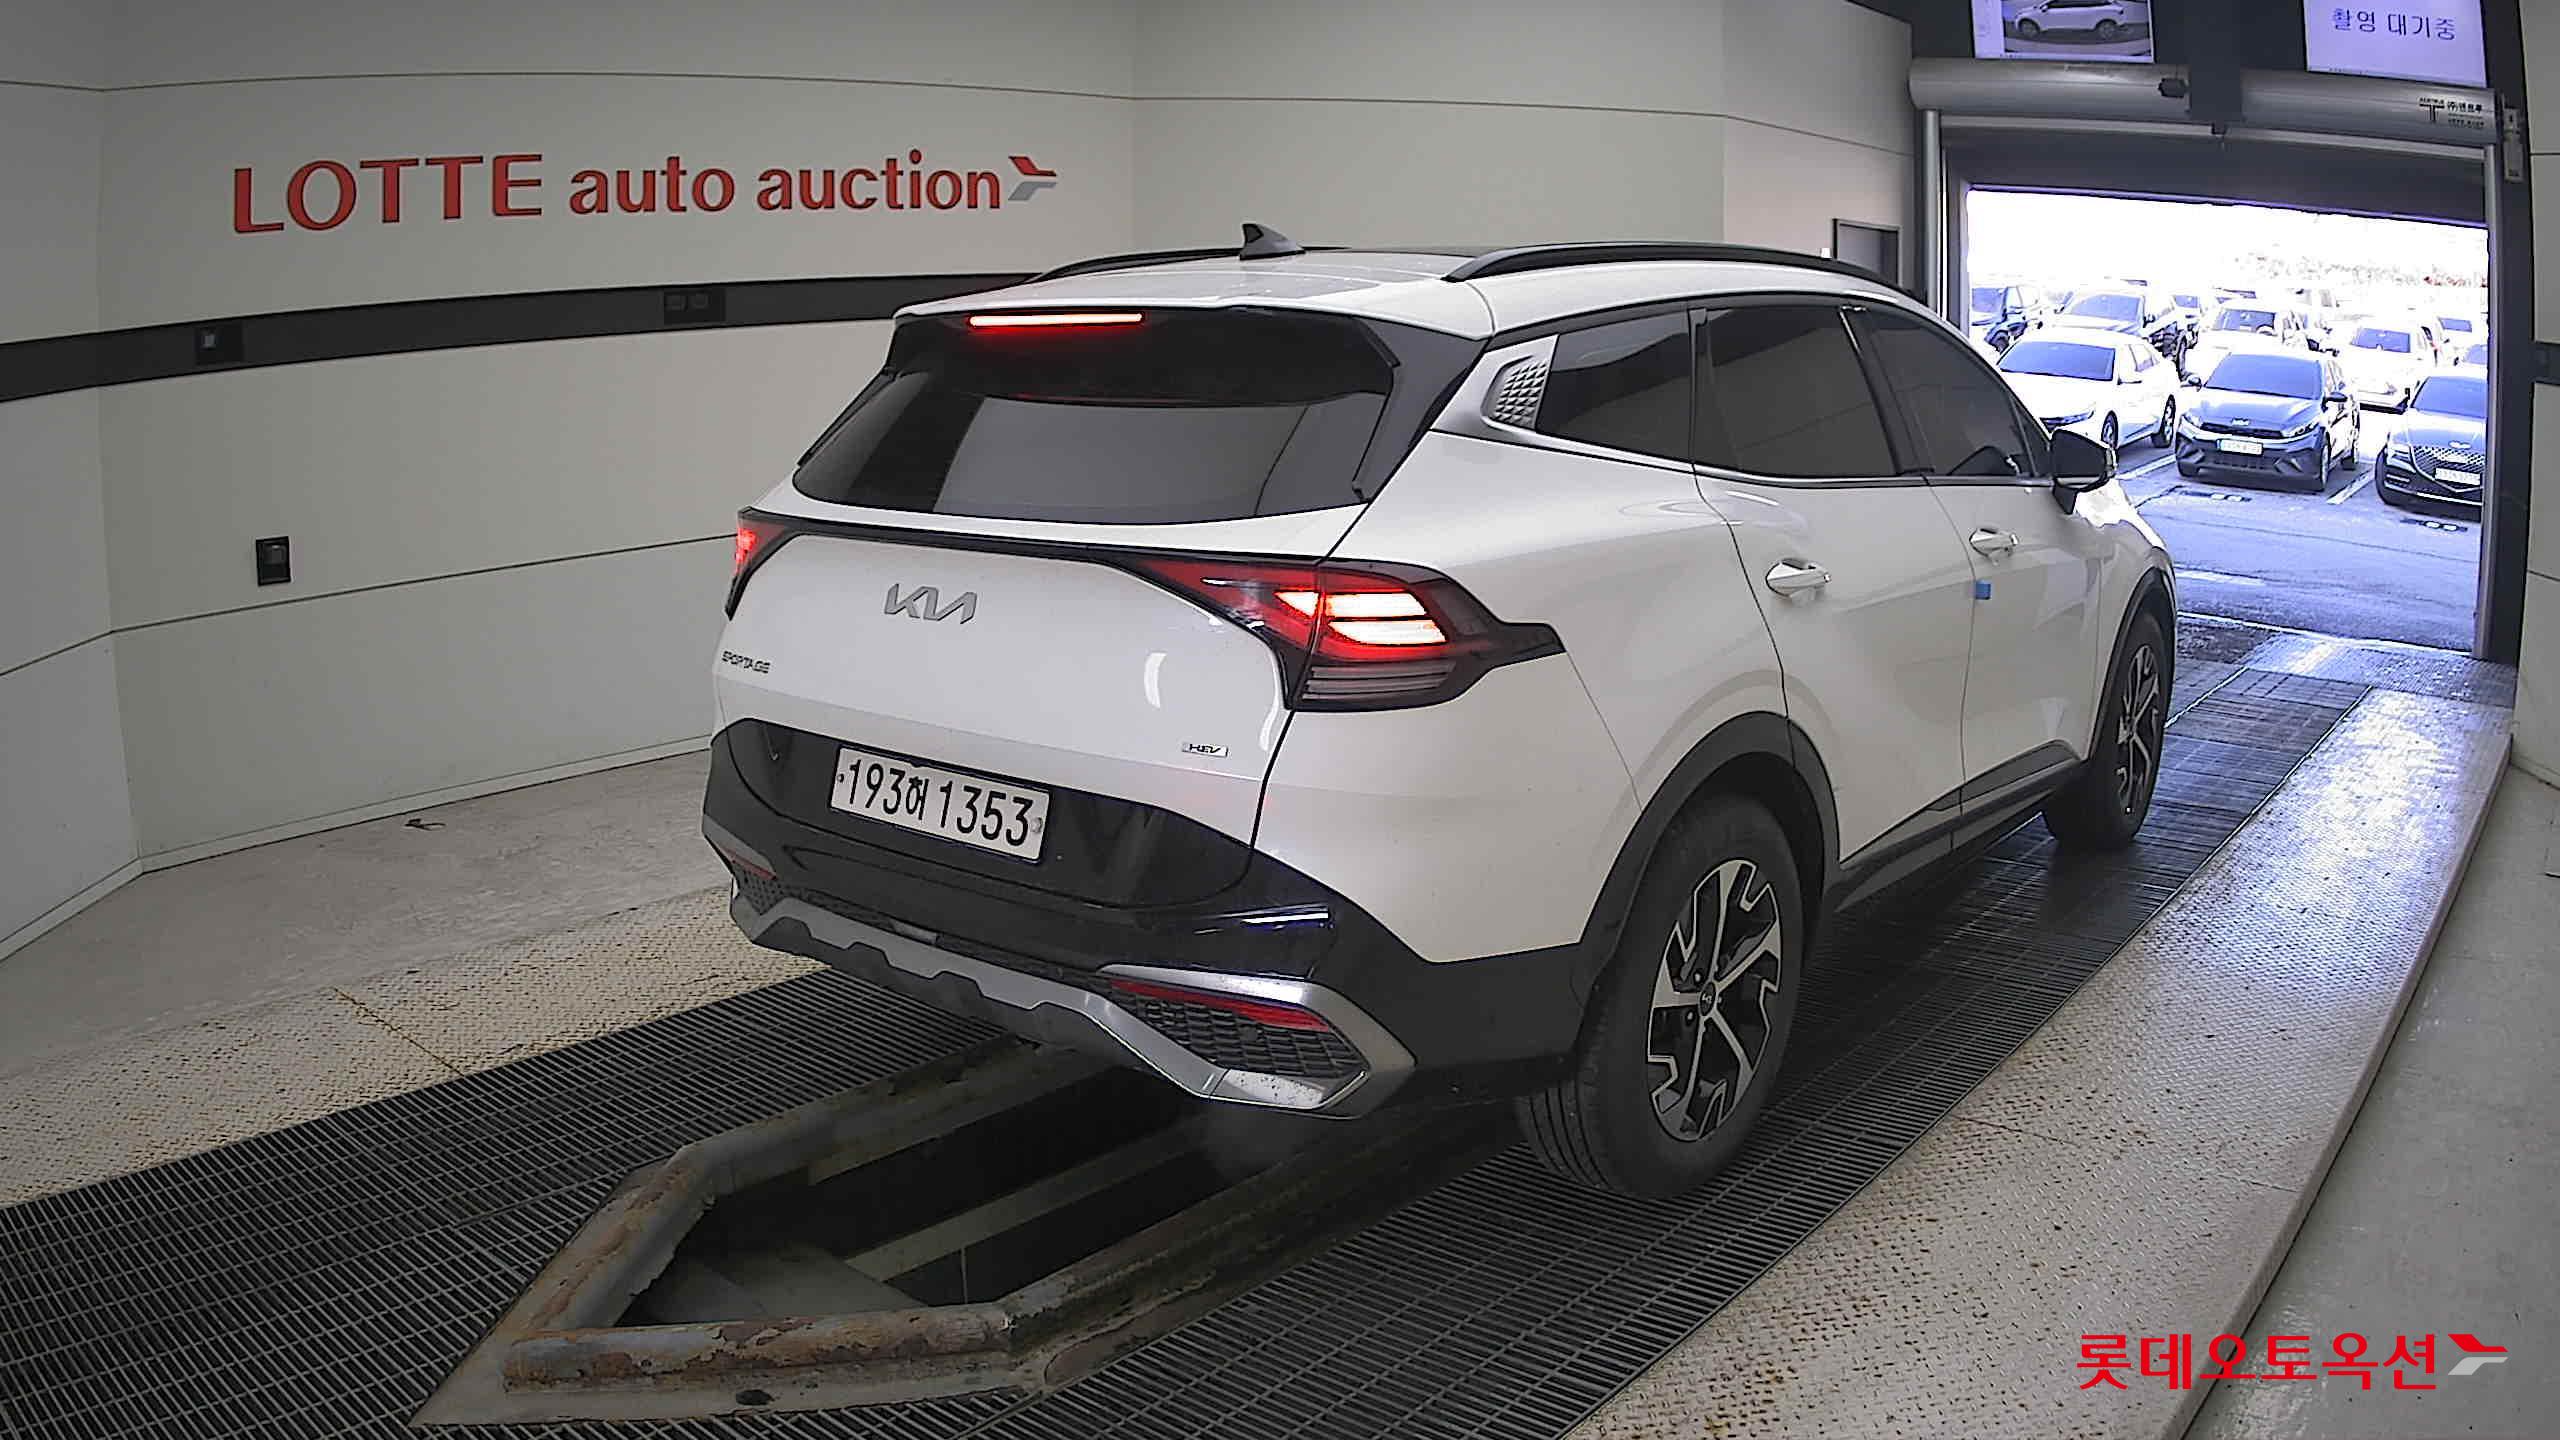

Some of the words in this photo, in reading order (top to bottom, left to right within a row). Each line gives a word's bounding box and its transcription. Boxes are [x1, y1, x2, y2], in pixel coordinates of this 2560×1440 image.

[2333, 7, 2377, 32] 촬영
[2388, 14, 2456, 41] 대기중
[234, 155, 542, 234] LOTTE
[569, 155, 736, 215] auto
[757, 148, 1001, 213] auction
[884, 583, 978, 625] KIA
[849, 759, 930, 821] 193허
[939, 780, 1034, 847] 1353
